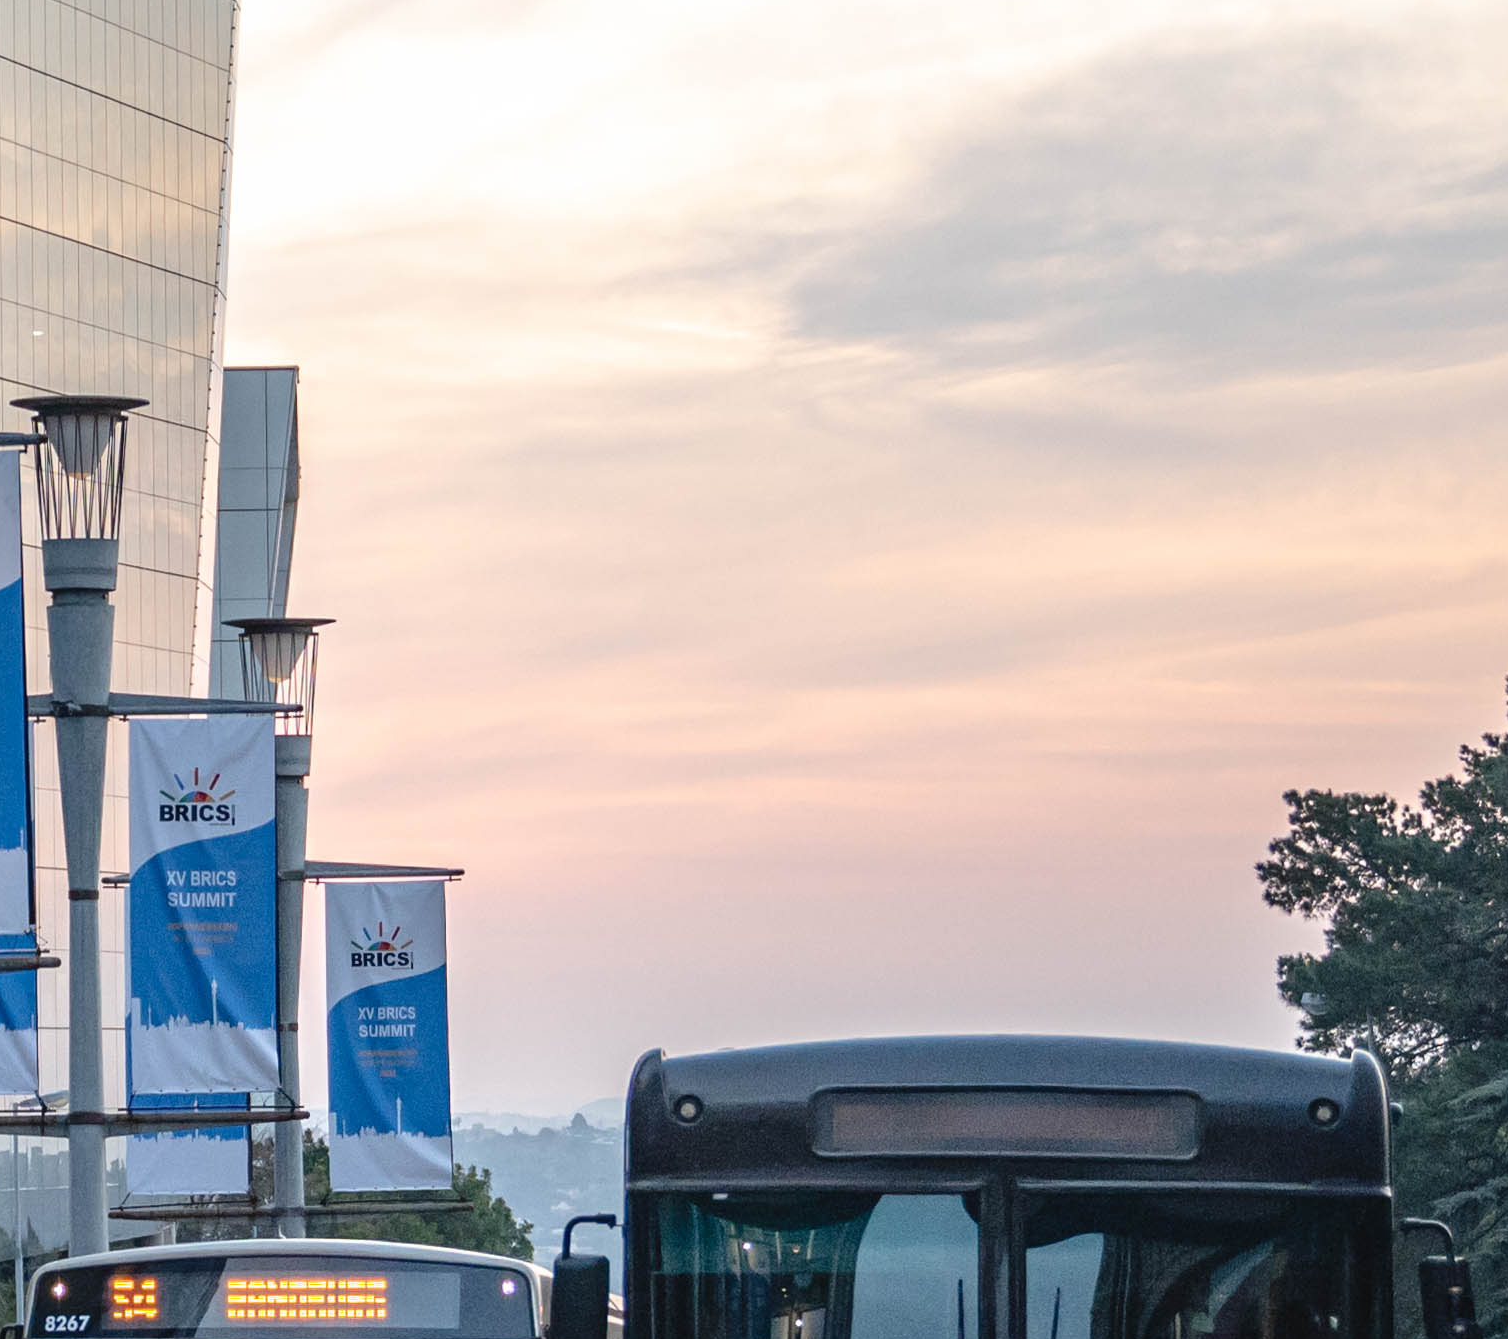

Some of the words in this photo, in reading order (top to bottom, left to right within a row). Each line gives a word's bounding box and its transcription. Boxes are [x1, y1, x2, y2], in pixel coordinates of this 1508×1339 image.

[159, 804, 230, 822] BRICS
[166, 870, 186, 887] XV
[190, 870, 237, 887] BRICS
[167, 892, 237, 908] SUMMIT
[351, 952, 410, 967] BRICS
[358, 1006, 374, 1020] XV
[377, 1006, 416, 1020] BRICS
[358, 1024, 416, 1038] SUMMIT
[44, 1314, 89, 1332] 8267
